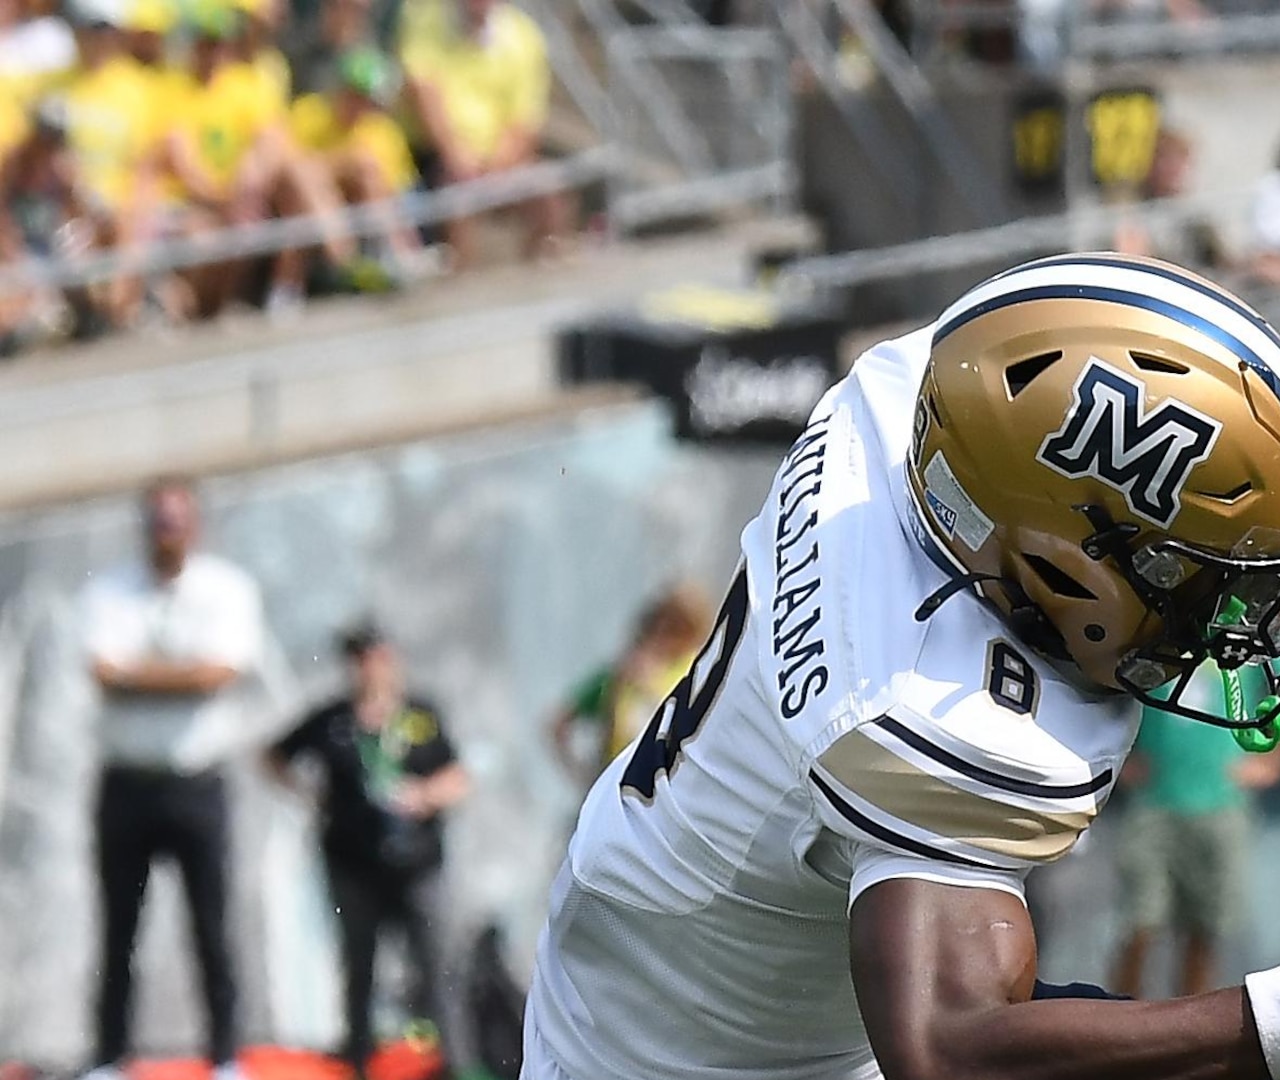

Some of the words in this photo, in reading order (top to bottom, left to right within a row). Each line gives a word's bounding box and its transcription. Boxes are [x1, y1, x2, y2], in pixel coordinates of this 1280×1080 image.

[1035, 355, 1224, 530] M
[773, 413, 833, 720] WILLIAMS
[983, 638, 1041, 720] 8
